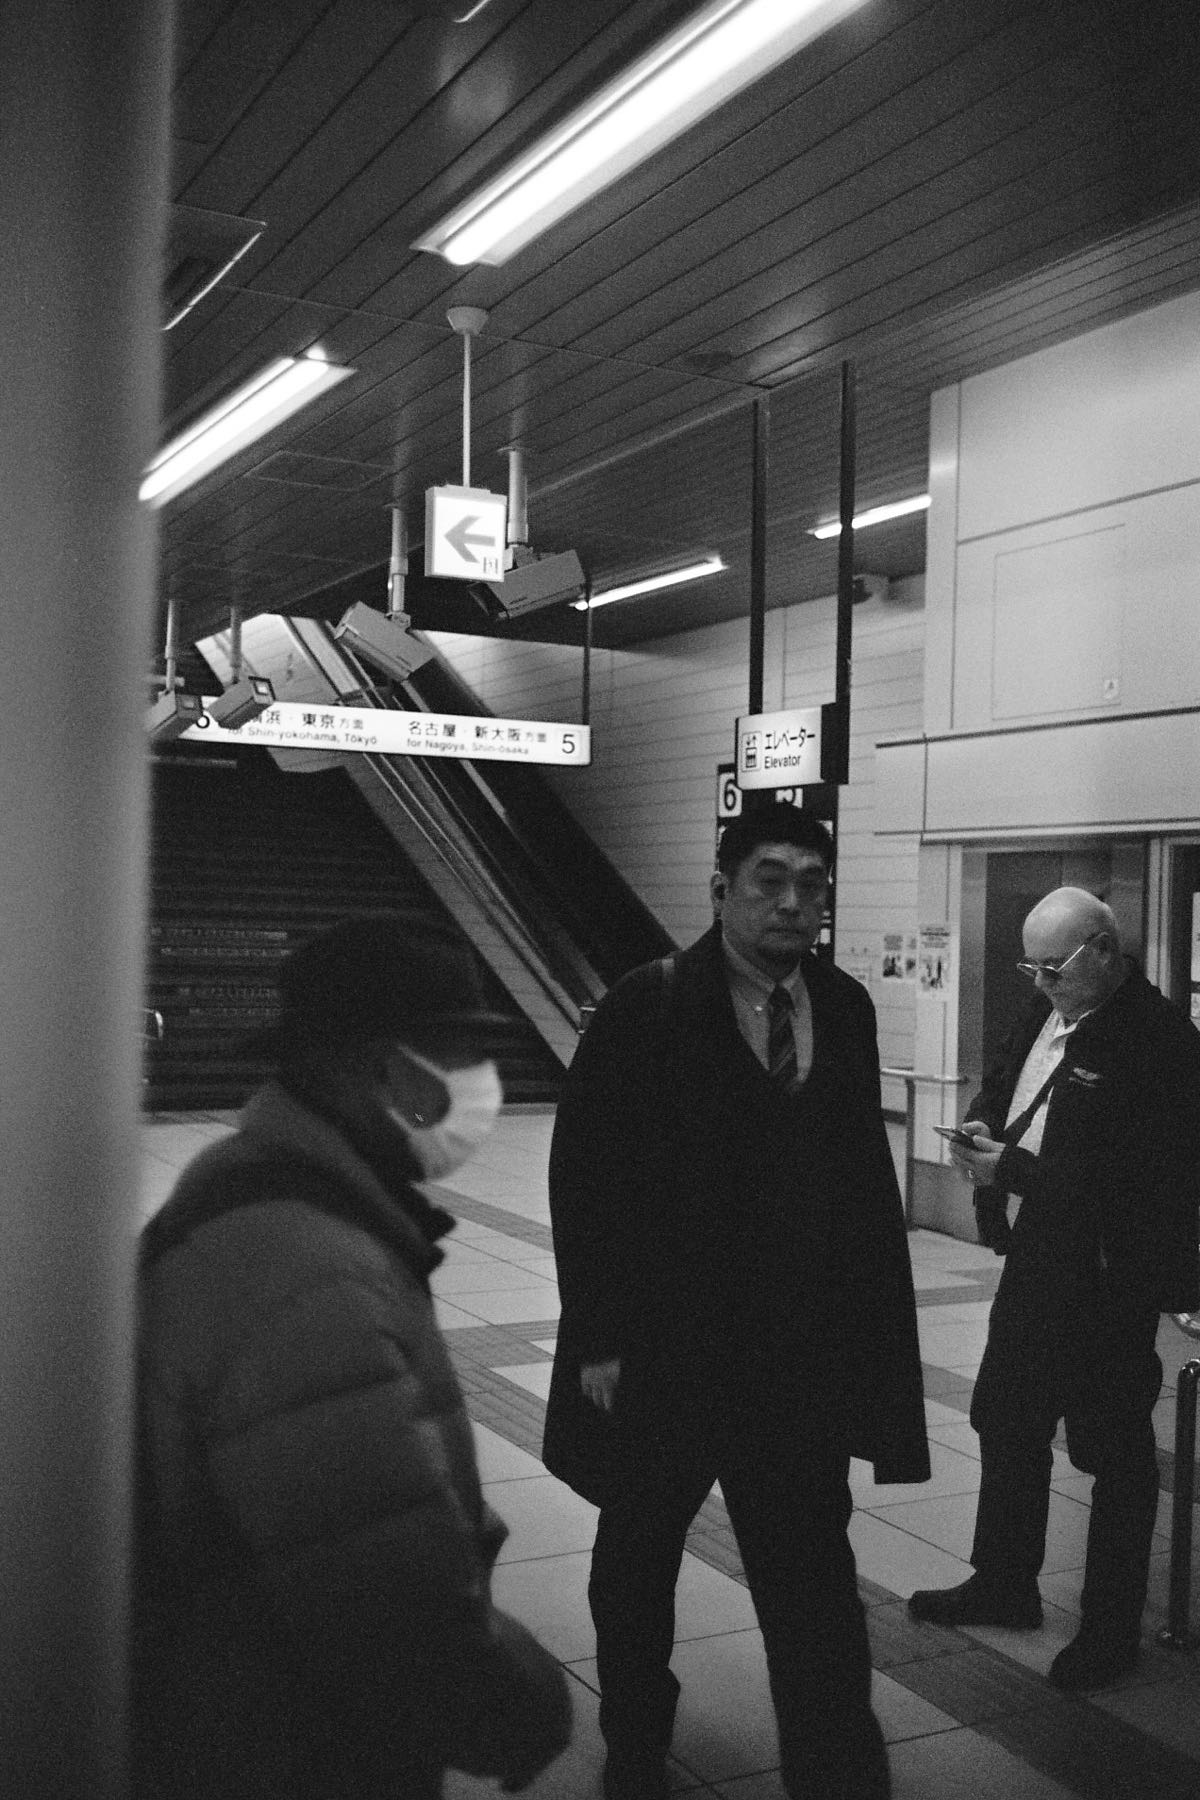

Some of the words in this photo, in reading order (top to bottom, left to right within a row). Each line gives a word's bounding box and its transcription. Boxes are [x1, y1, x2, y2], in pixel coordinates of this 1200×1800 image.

[255, 710, 364, 730] 浜・東京方面
[407, 738, 421, 748] for
[562, 733, 576, 754] 5
[765, 727, 816, 750] エレベーター
[764, 754, 801, 770] Elevator
[723, 778, 737, 812] 6
